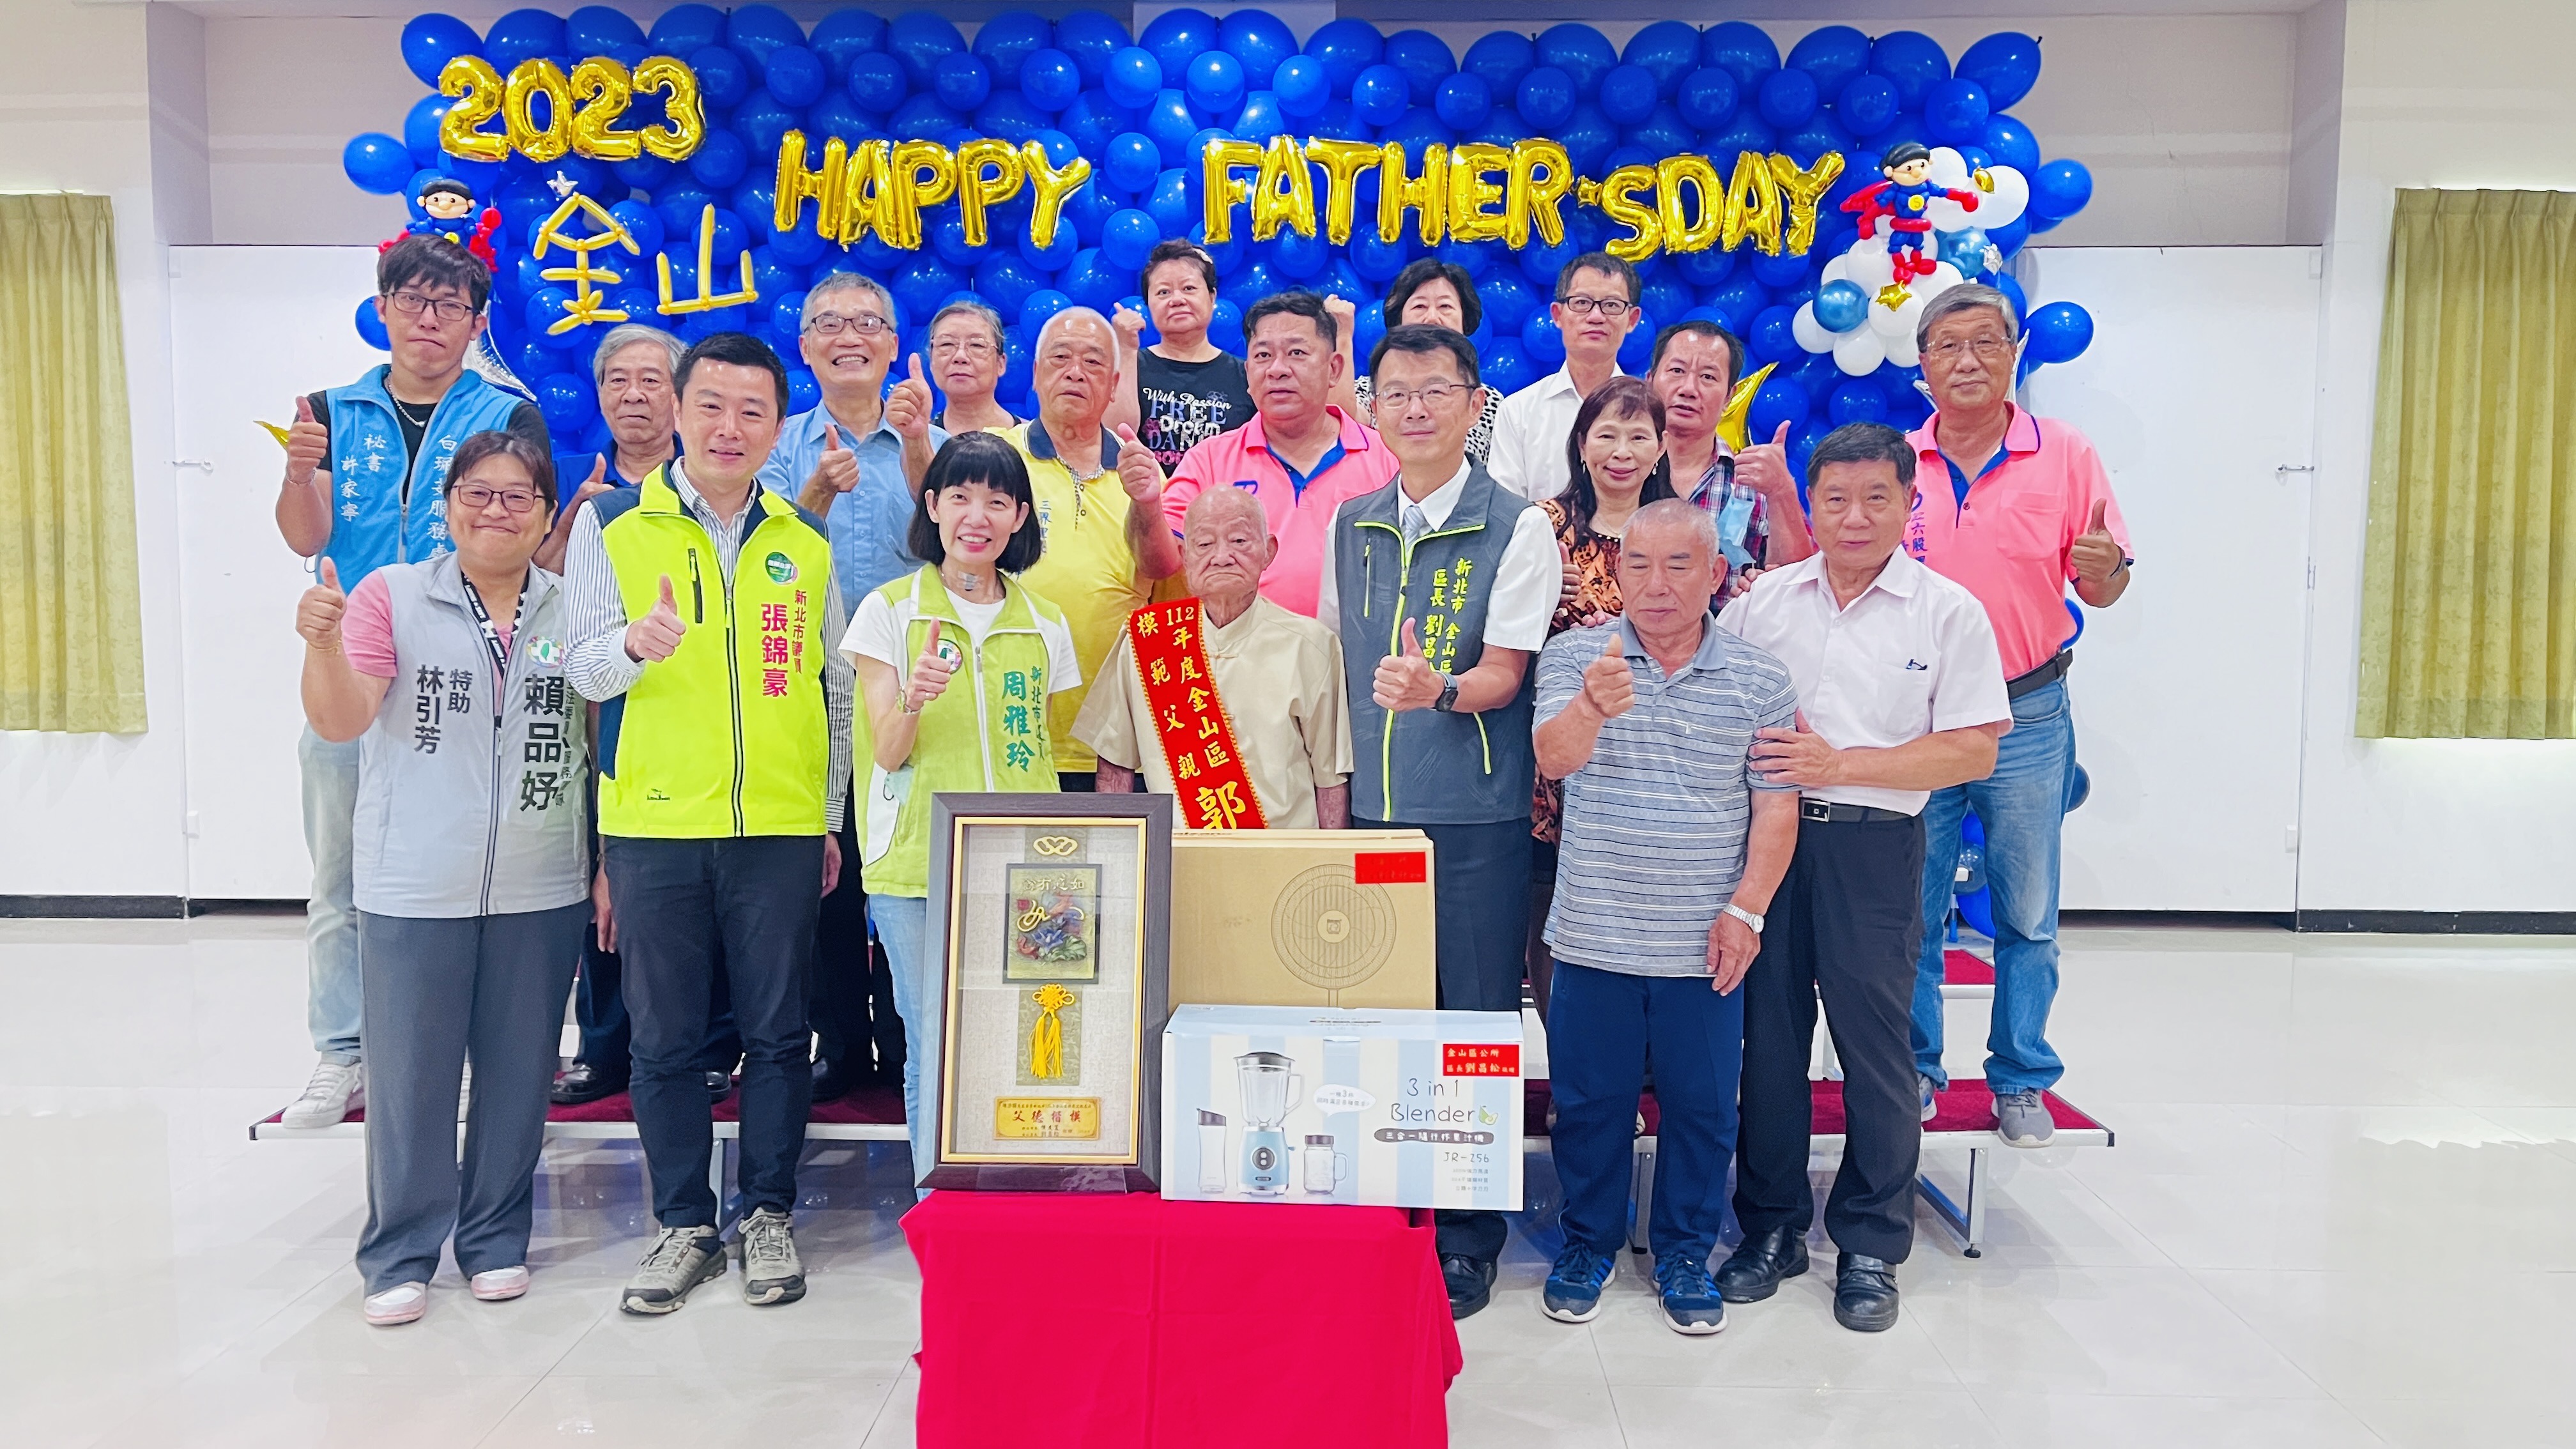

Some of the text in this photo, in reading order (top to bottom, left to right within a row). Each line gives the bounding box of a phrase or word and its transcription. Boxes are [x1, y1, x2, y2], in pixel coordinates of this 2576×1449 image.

[438, 54, 706, 163] 2023
[774, 128, 1092, 252] HAPPY
[532, 192, 758, 337] 金山
[1149, 397, 1227, 425] FREE
[340, 454, 361, 523] 許家寧
[1422, 568, 1448, 673] 區長 劉昌
[1450, 557, 1473, 615] 新北市
[760, 603, 788, 698] 張錦豪
[792, 589, 807, 675] 新北市議員
[414, 664, 445, 755] 林引芳
[447, 669, 473, 714] 特助
[1001, 670, 1036, 773] 周雅玲
[1137, 611, 1201, 781] 模範父親
[519, 673, 565, 812] 賴品妤
[1195, 780, 1246, 829] 郭
[1390, 1103, 1476, 1123] Blender
[1407, 1078, 1419, 1096] 3
[1428, 1080, 1445, 1096] in
[1443, 1152, 1490, 1163] JR-256
